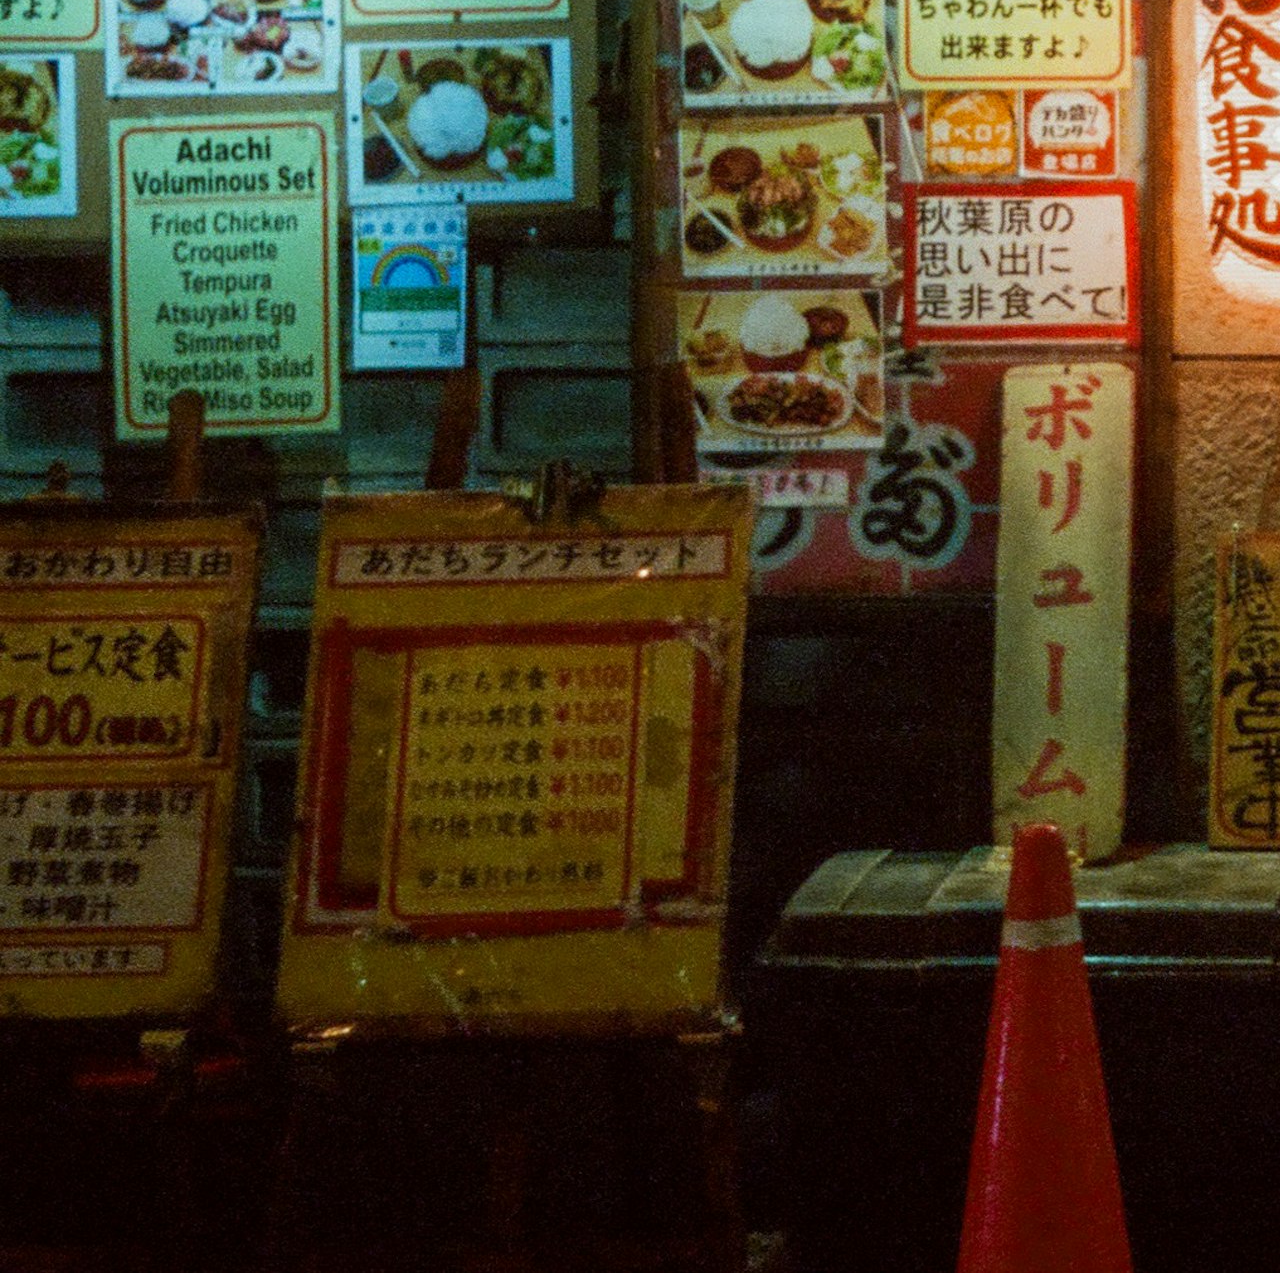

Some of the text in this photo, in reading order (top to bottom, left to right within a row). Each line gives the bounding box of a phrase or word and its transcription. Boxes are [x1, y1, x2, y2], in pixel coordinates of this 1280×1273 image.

[177, 135, 272, 165] Adachi
[132, 165, 317, 197] Voluminous Set
[150, 209, 299, 236] Fried Chicken
[916, 198, 1074, 235] 秋葉原の
[172, 239, 278, 266] Croquette
[916, 242, 1073, 278] 思い出に
[178, 269, 273, 297] Tempura
[154, 297, 297, 327] Atsuyaki Egg
[173, 329, 281, 355] Simmered
[138, 353, 315, 389] Vegetable, Salad
[203, 387, 254, 413] Miso
[260, 385, 314, 414] Soup
[5, 548, 234, 578] おかわり自由
[360, 539, 700, 575] あだちランチセット
